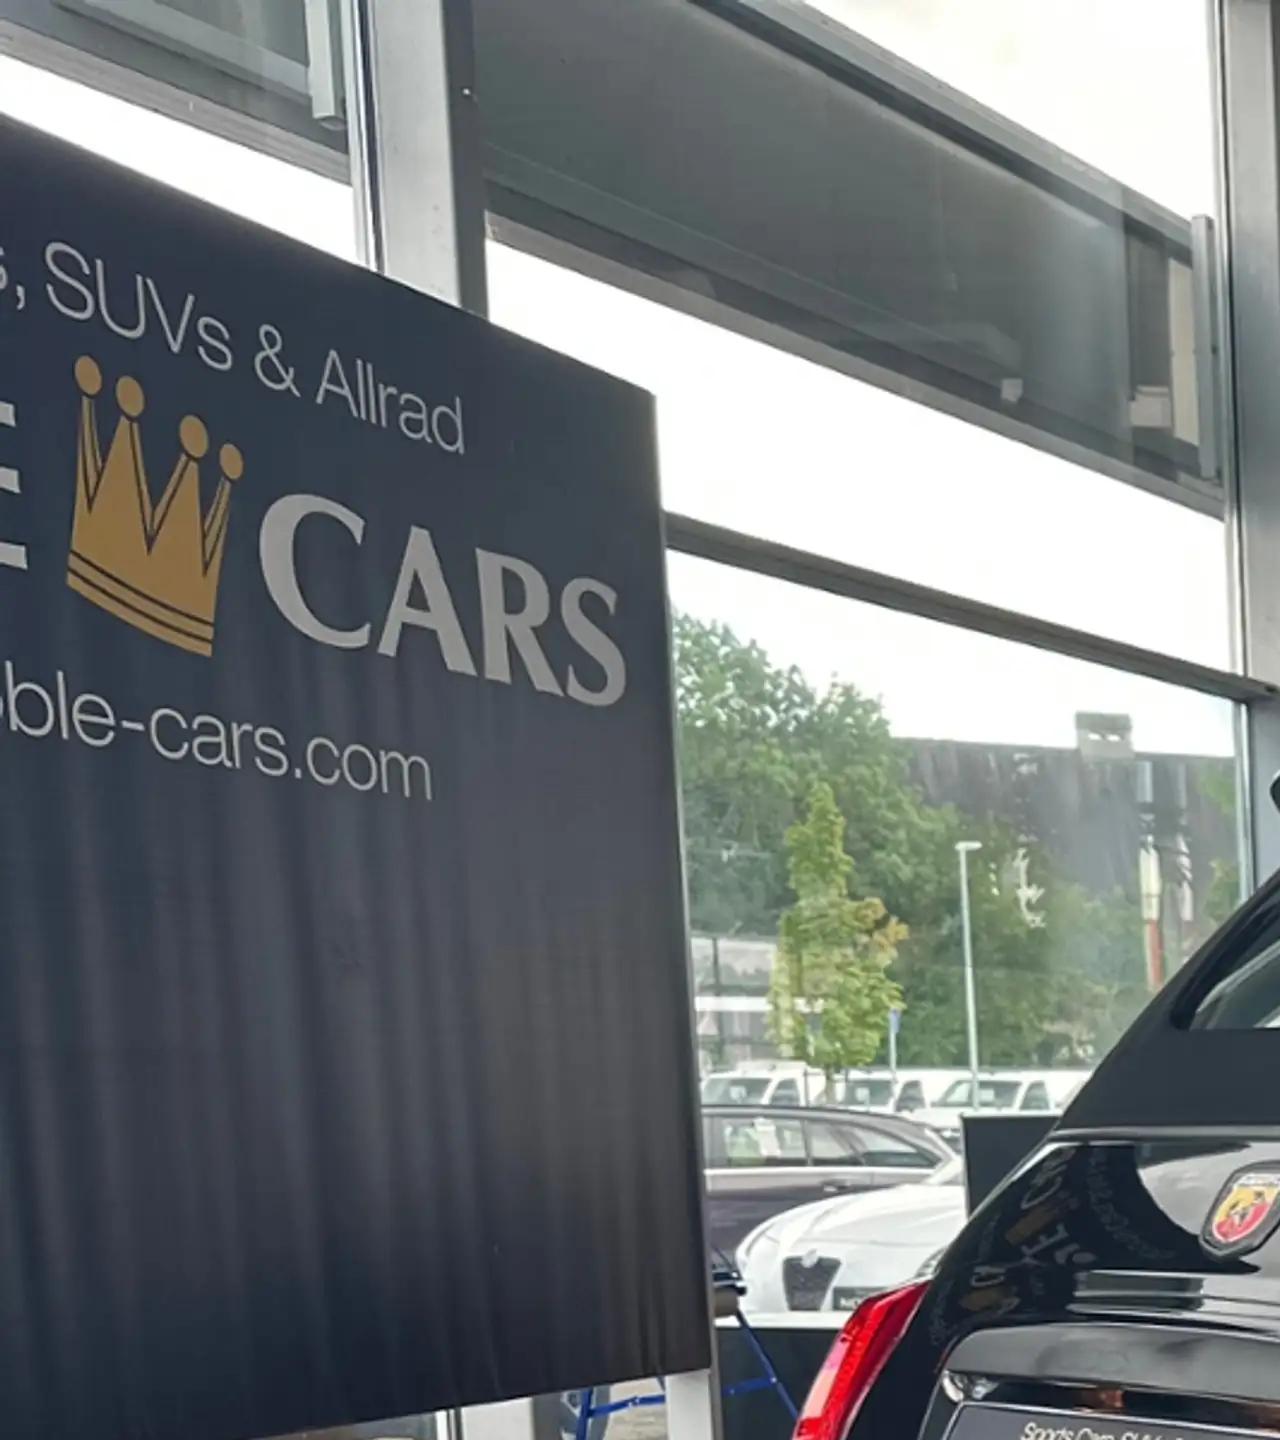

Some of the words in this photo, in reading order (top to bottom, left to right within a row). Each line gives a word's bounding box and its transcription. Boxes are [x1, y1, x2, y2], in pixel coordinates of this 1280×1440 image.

[45, 242, 233, 371] SUVs
[254, 324, 301, 397] &
[316, 350, 465, 455] Allrad
[259, 493, 627, 707] CARS
[0, 660, 432, 801] ble-cars.com
